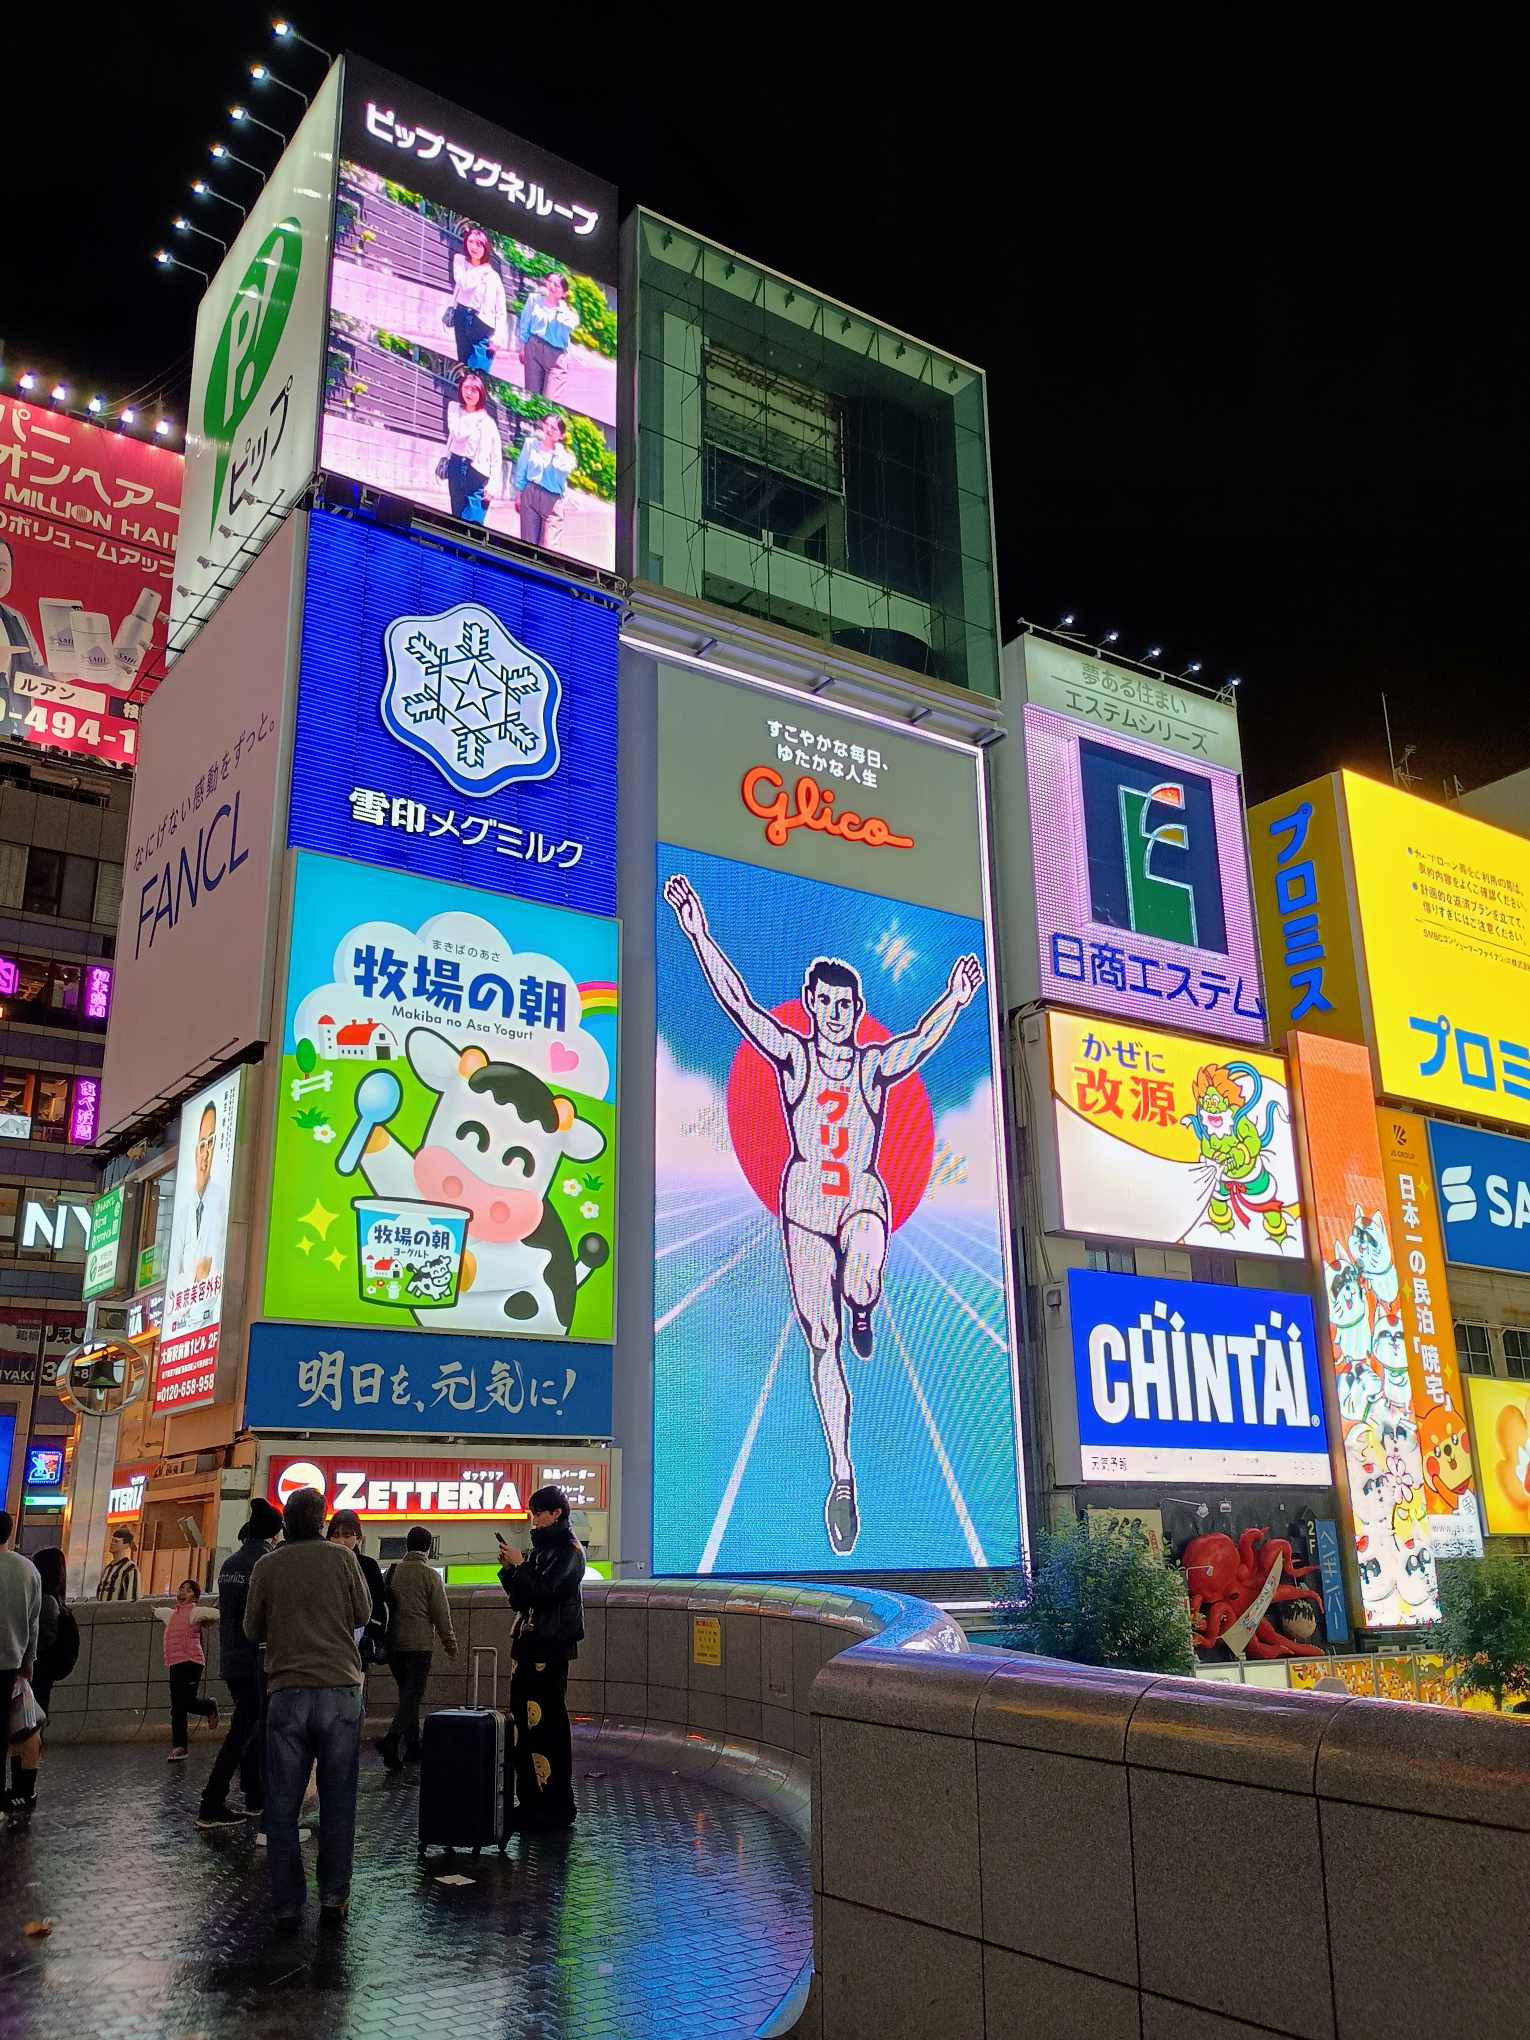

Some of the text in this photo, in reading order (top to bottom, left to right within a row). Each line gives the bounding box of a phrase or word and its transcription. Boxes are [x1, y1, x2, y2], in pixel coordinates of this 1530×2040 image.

[366, 102, 599, 235] ピップマグネループ
[229, 374, 294, 516] ピップ
[4, 482, 113, 532] MILLION
[20, 678, 76, 701] ルアン
[1081, 662, 1188, 715] 夢ある住まい
[0, 696, 137, 755] -494-1
[767, 719, 889, 771] すこやかな毎日、
[1065, 689, 1208, 756] エステムシリーズ
[133, 711, 275, 872] なにげない感動をずっと。
[777, 743, 879, 789] ゆたかな人生
[348, 785, 584, 869] 雪印メグミルク
[741, 765, 916, 848] Glico
[134, 789, 250, 961] FANCL
[1269, 801, 1335, 1022] プロミス
[432, 939, 502, 963] まきばのあさ
[1051, 931, 1268, 1021] 日商エステム
[353, 944, 567, 1033] 牧場の朝
[391, 1005, 533, 1041] Makiba no Asa Yogurt
[1081, 1032, 1166, 1074] かぜに
[1074, 1066, 1179, 1128] 改源
[816, 1085, 851, 1198] グリコ
[374, 1224, 450, 1250] 牧場の朝
[393, 1247, 430, 1260] ヨーグルト
[335, 1471, 522, 1511] ZETTERIA
[463, 1470, 503, 1483] ゼッテリア
